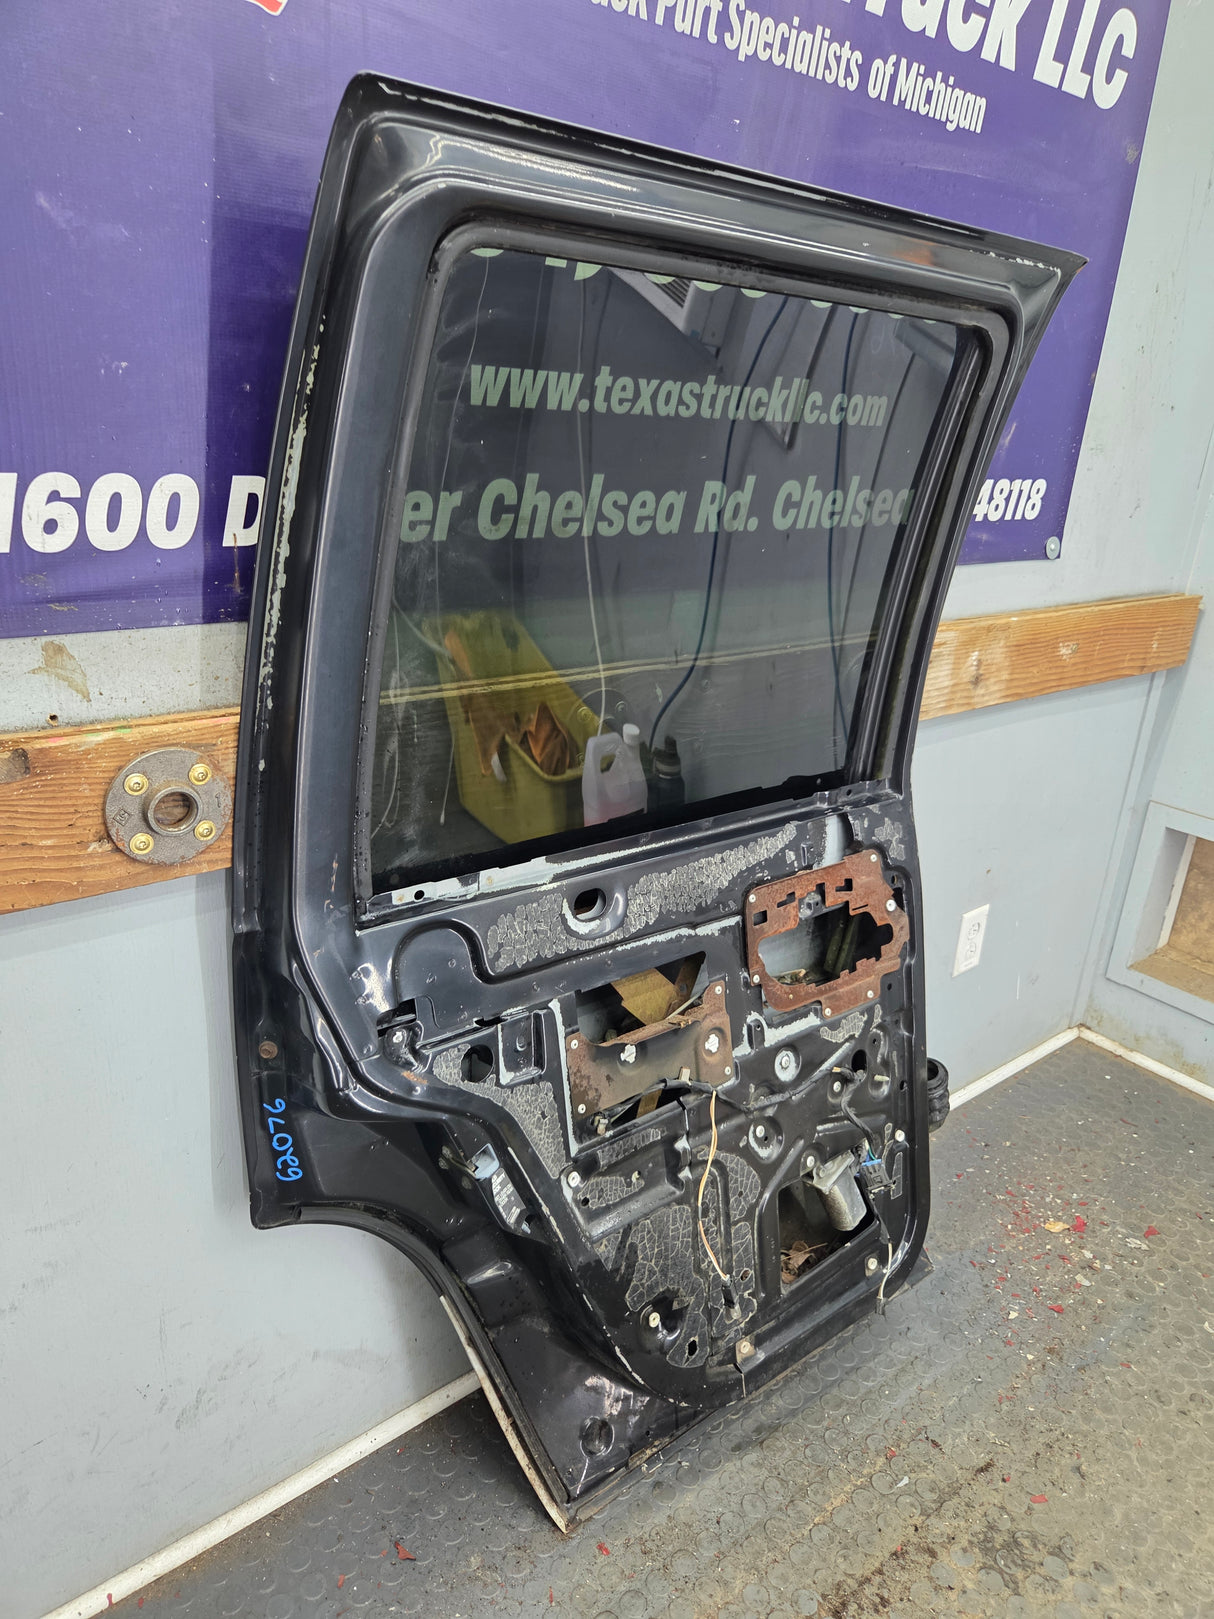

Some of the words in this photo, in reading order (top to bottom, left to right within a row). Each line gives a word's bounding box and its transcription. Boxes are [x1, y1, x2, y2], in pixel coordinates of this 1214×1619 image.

[724, 0, 862, 92] Specialists
[867, 54, 897, 102] of
[892, 57, 987, 134] Michigan
[470, 364, 888, 427] www.texastruckllc.com
[477, 473, 687, 541] Chelsea
[693, 475, 758, 533] Rd.
[772, 473, 915, 529] Chelsea
[972, 478, 1048, 522] 48118
[262, 1097, 304, 1182] 62076
